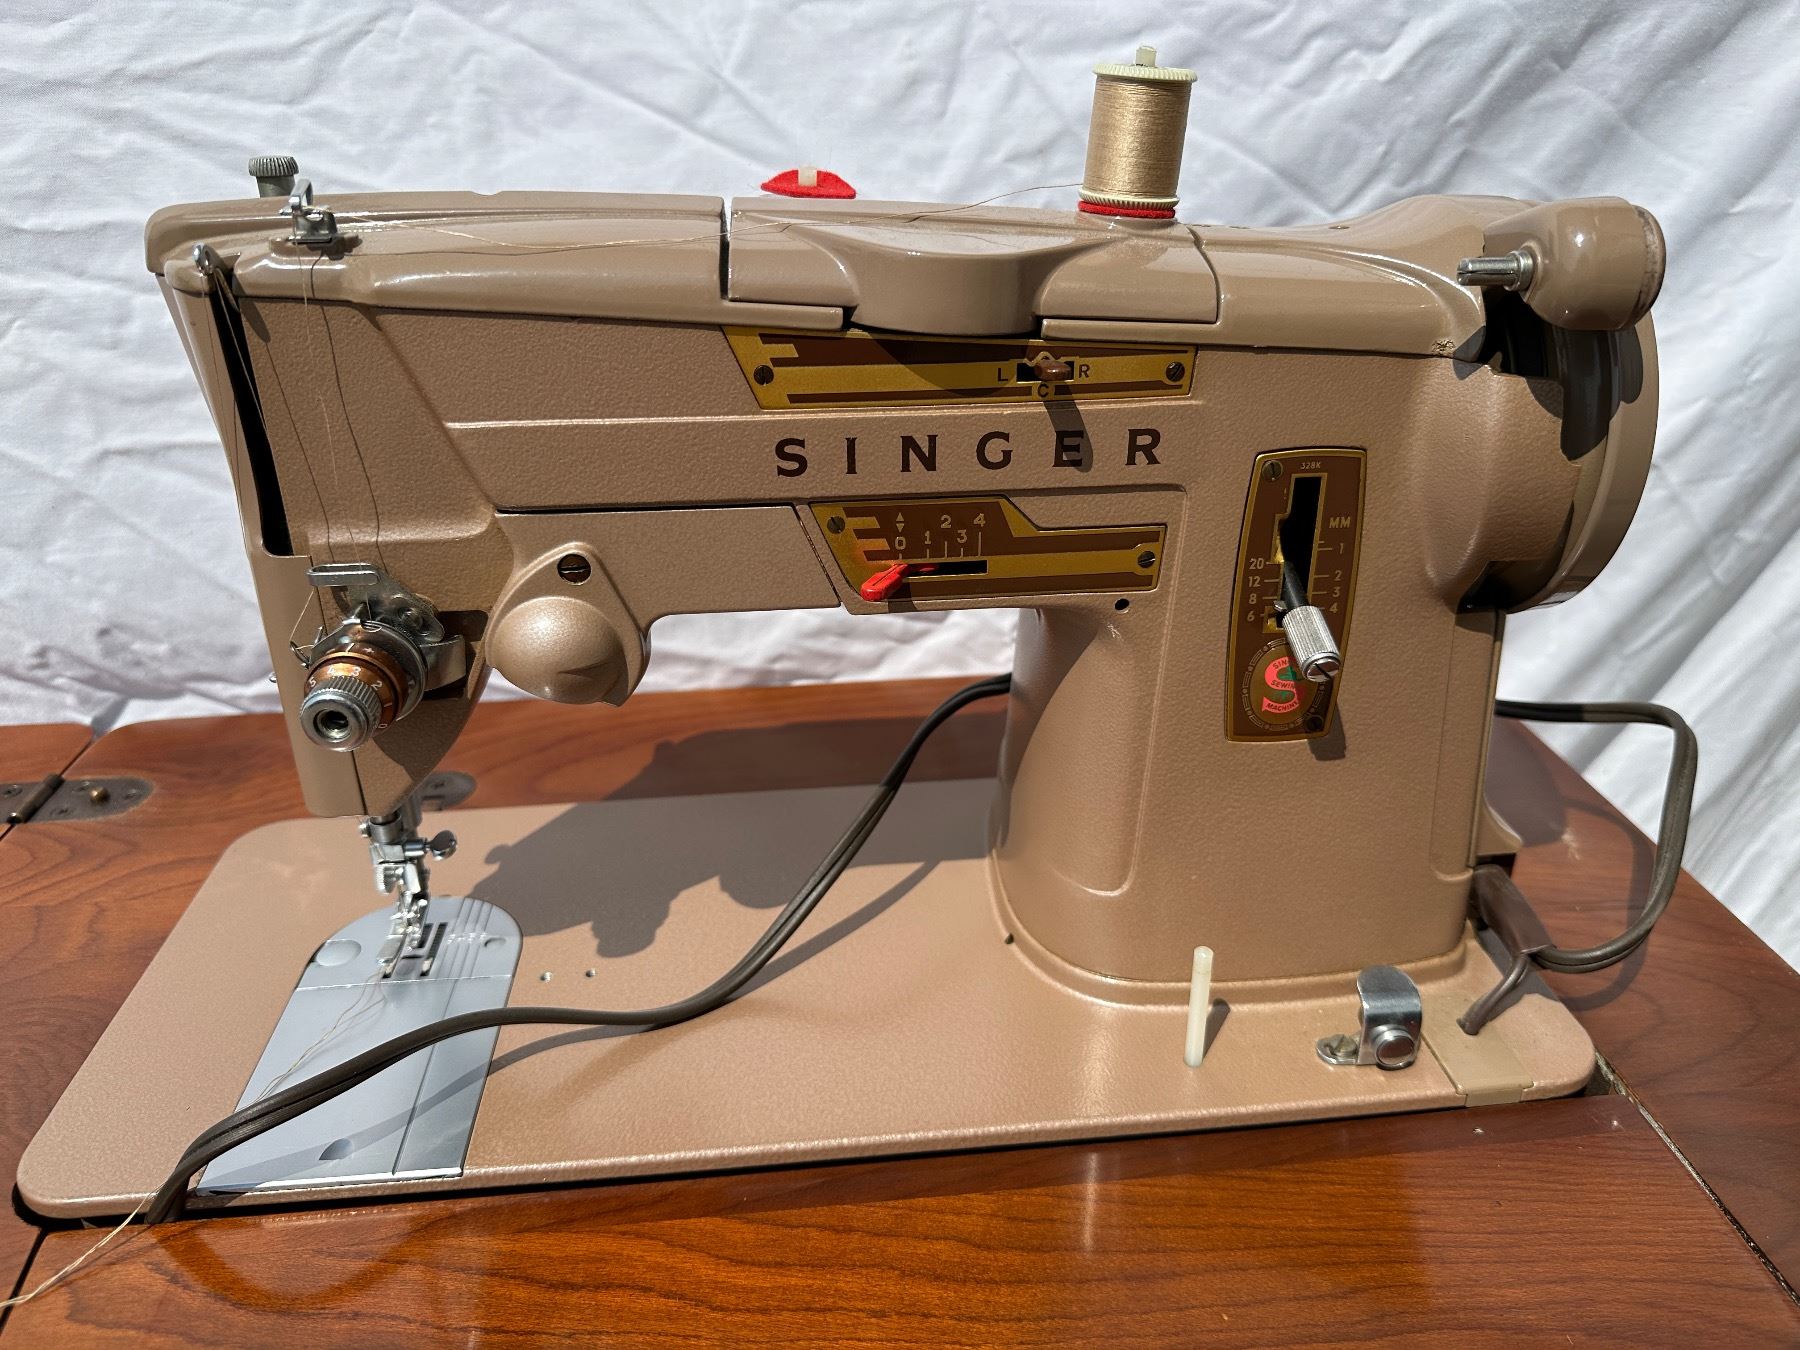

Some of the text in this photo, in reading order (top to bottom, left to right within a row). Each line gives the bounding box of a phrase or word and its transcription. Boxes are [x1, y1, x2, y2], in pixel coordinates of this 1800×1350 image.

[997, 368, 1008, 382] L
[1079, 364, 1090, 378] R
[1037, 384, 1049, 397] C
[774, 428, 1161, 477] SINGER
[1300, 461, 1321, 470] 328K
[941, 514, 951, 528] 2
[973, 513, 986, 527] 4
[1329, 516, 1351, 529] MM
[925, 530, 931, 545] 1
[957, 529, 968, 543] 3
[895, 536, 906, 550] 0
[1339, 543, 1344, 554] 1
[1250, 558, 1264, 570] 20
[1334, 570, 1342, 581] 2
[1248, 576, 1261, 587] 12
[1333, 587, 1341, 597] 3
[1248, 594, 1256, 604] 8
[1330, 603, 1338, 614] 4
[1247, 610, 1255, 621] 6
[327, 664, 337, 674] 4
[351, 666, 361, 677] 3
[309, 677, 317, 687] 5
[371, 681, 382, 690] 2
